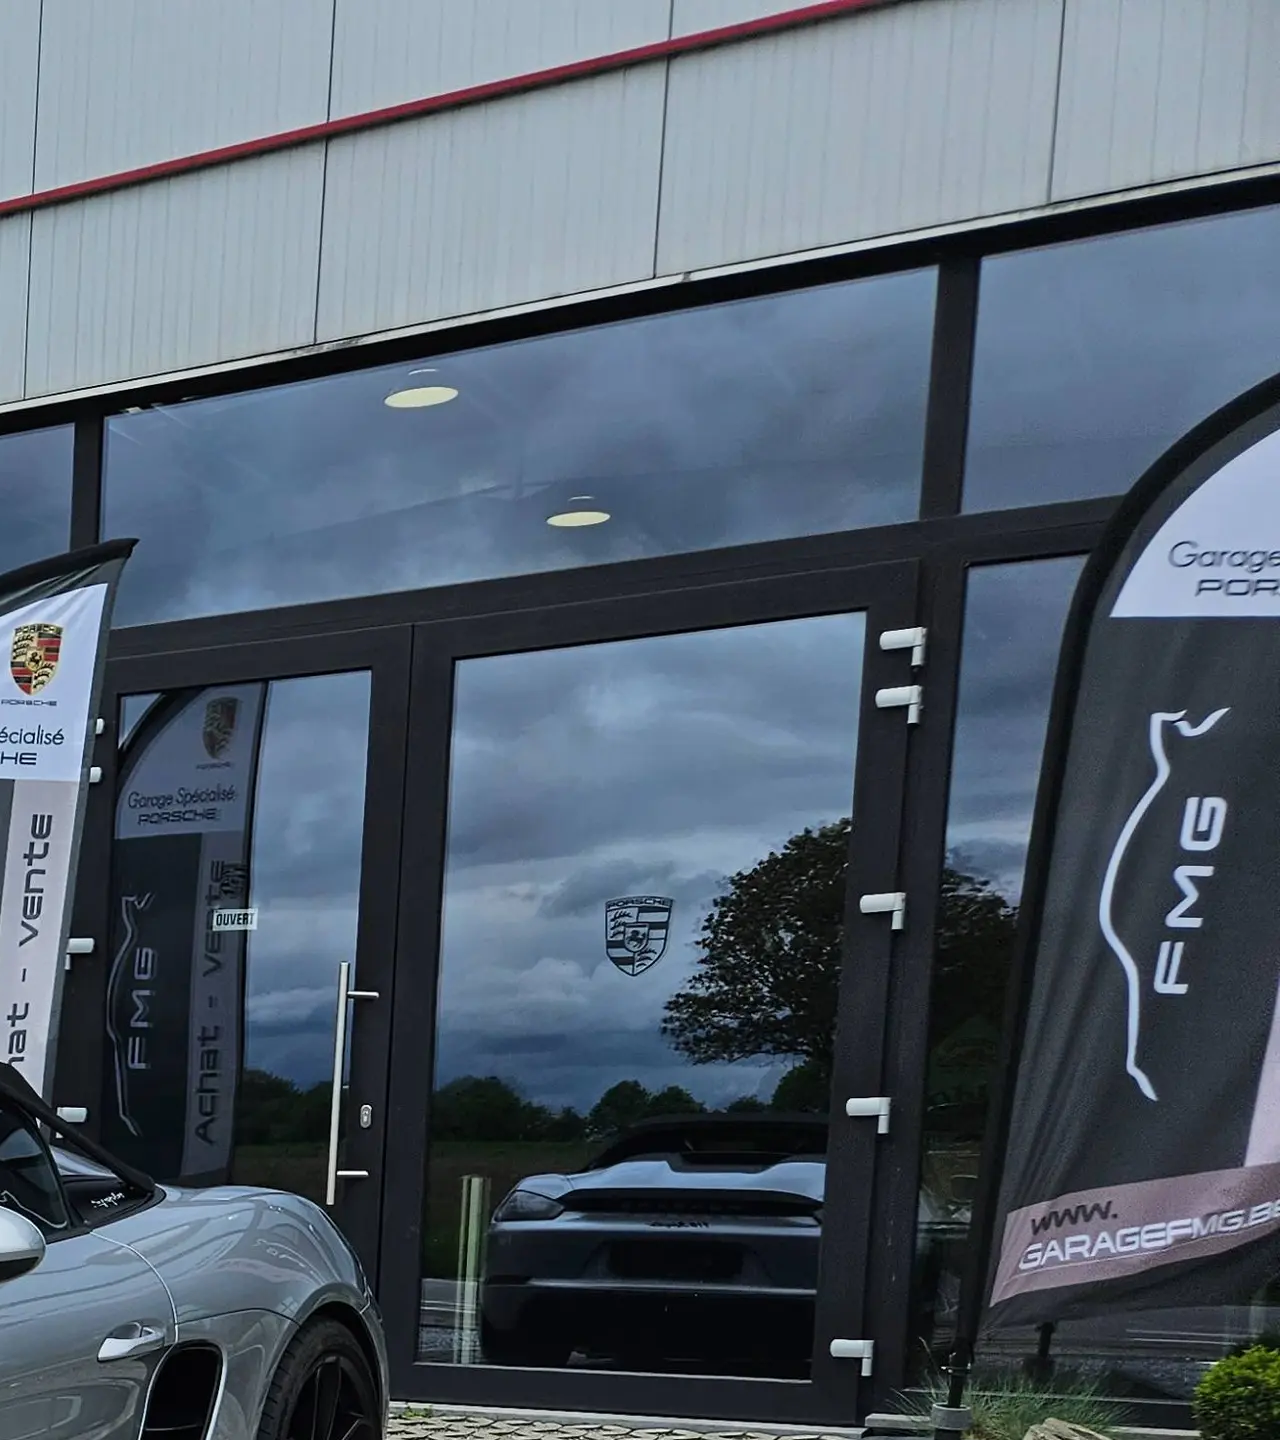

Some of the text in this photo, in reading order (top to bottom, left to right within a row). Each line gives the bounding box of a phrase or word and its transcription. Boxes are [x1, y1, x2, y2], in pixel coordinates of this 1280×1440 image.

[128, 783, 236, 810] Garage Spécialisé
[138, 808, 219, 825] PORSCHE
[1153, 796, 1228, 995] FMG
[216, 912, 256, 926] OUVERT
[127, 946, 158, 1070] FMG
